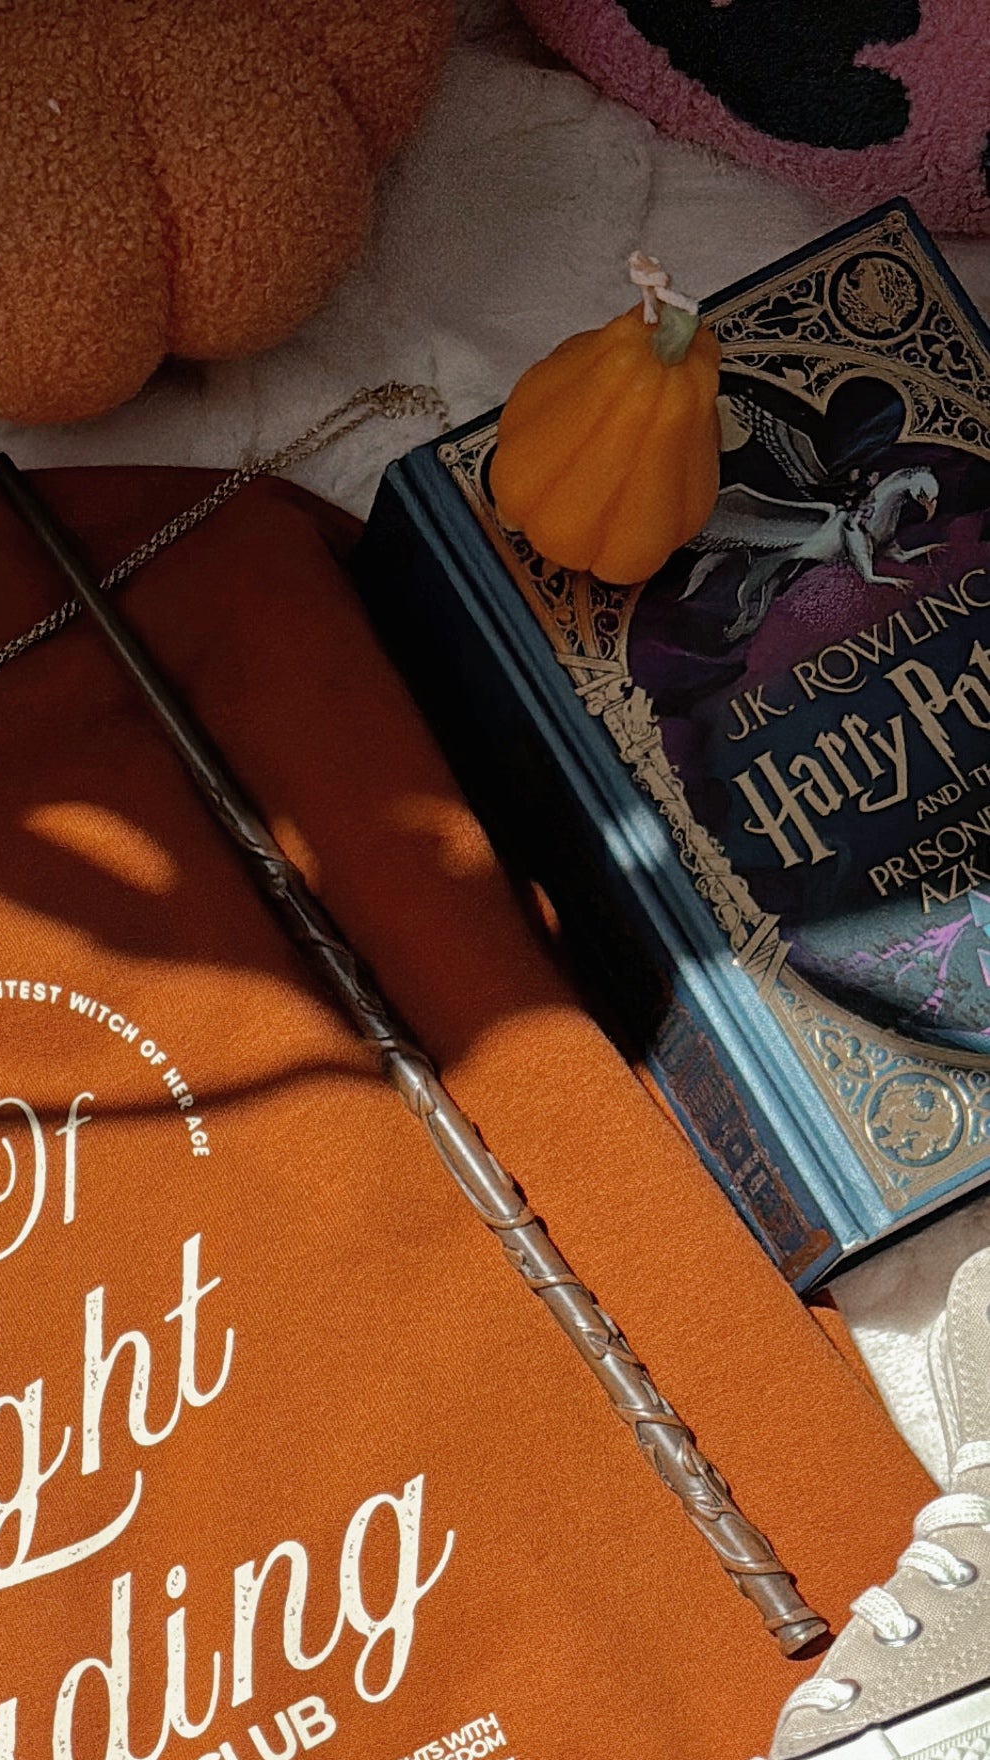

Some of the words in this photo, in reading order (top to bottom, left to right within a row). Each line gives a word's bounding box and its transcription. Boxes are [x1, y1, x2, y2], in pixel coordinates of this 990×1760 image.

[727, 684, 795, 741] J.K.
[731, 713, 909, 869] Harry
[916, 783, 963, 822] AND
[69, 991, 140, 1044] WITCH
[139, 1039, 168, 1066] OF
[162, 1067, 195, 1111] HER
[184, 1115, 211, 1158] AGE
[441, 1712, 500, 1751] WITH
